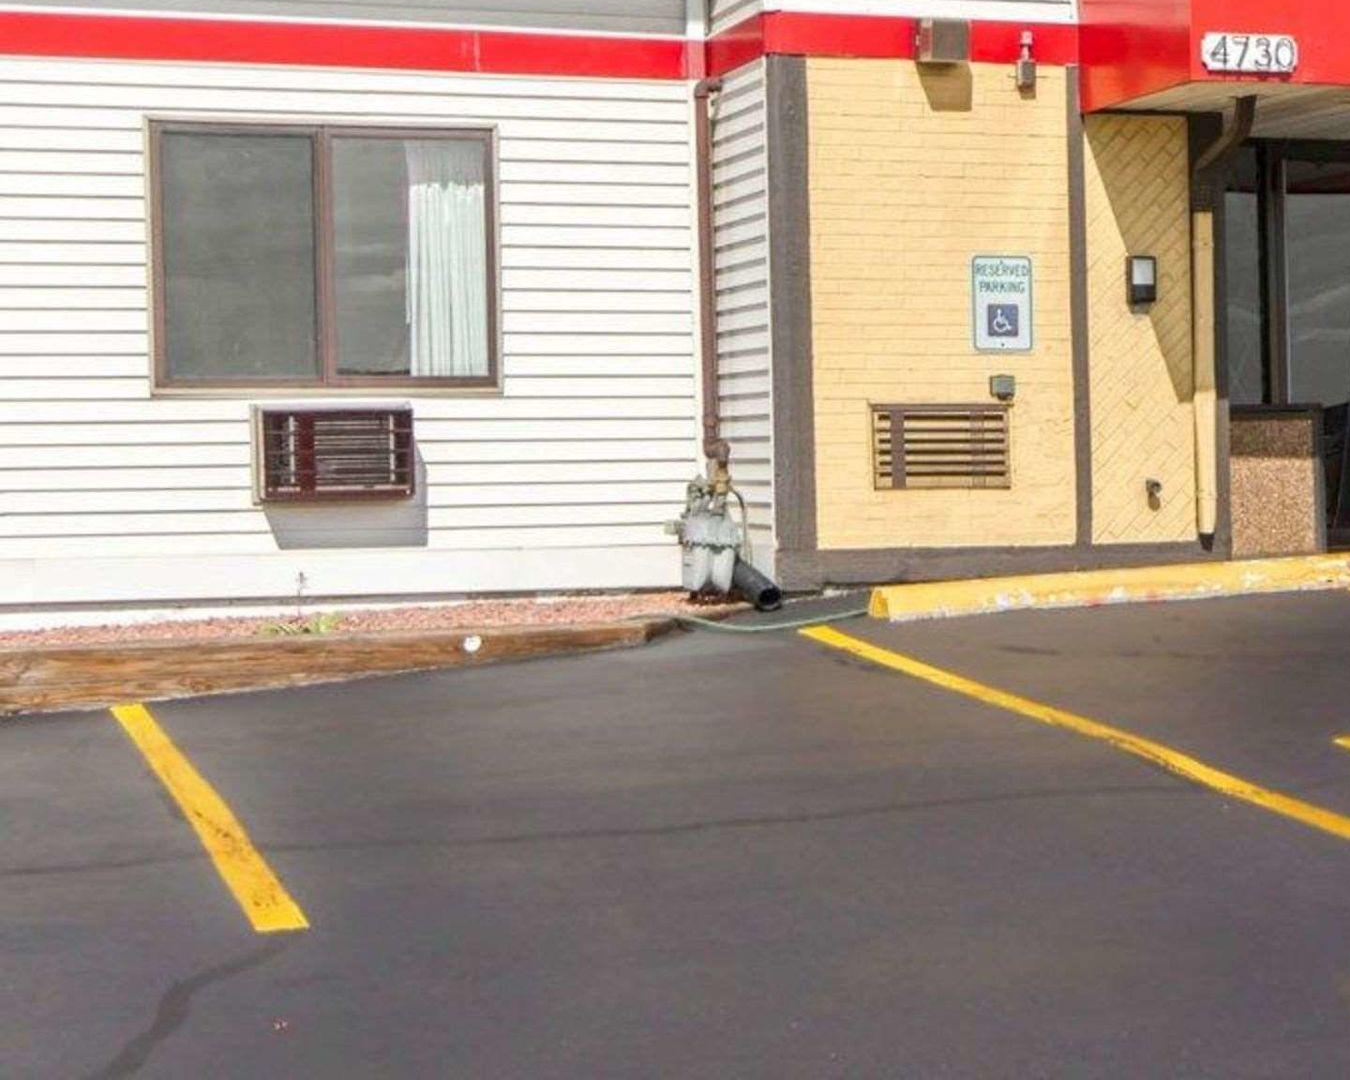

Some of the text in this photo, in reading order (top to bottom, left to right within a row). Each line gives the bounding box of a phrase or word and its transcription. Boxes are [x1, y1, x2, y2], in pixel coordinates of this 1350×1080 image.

[1210, 35, 1294, 68] 4730
[975, 263, 1029, 277] RESERVED
[979, 281, 1025, 294] PARKING
